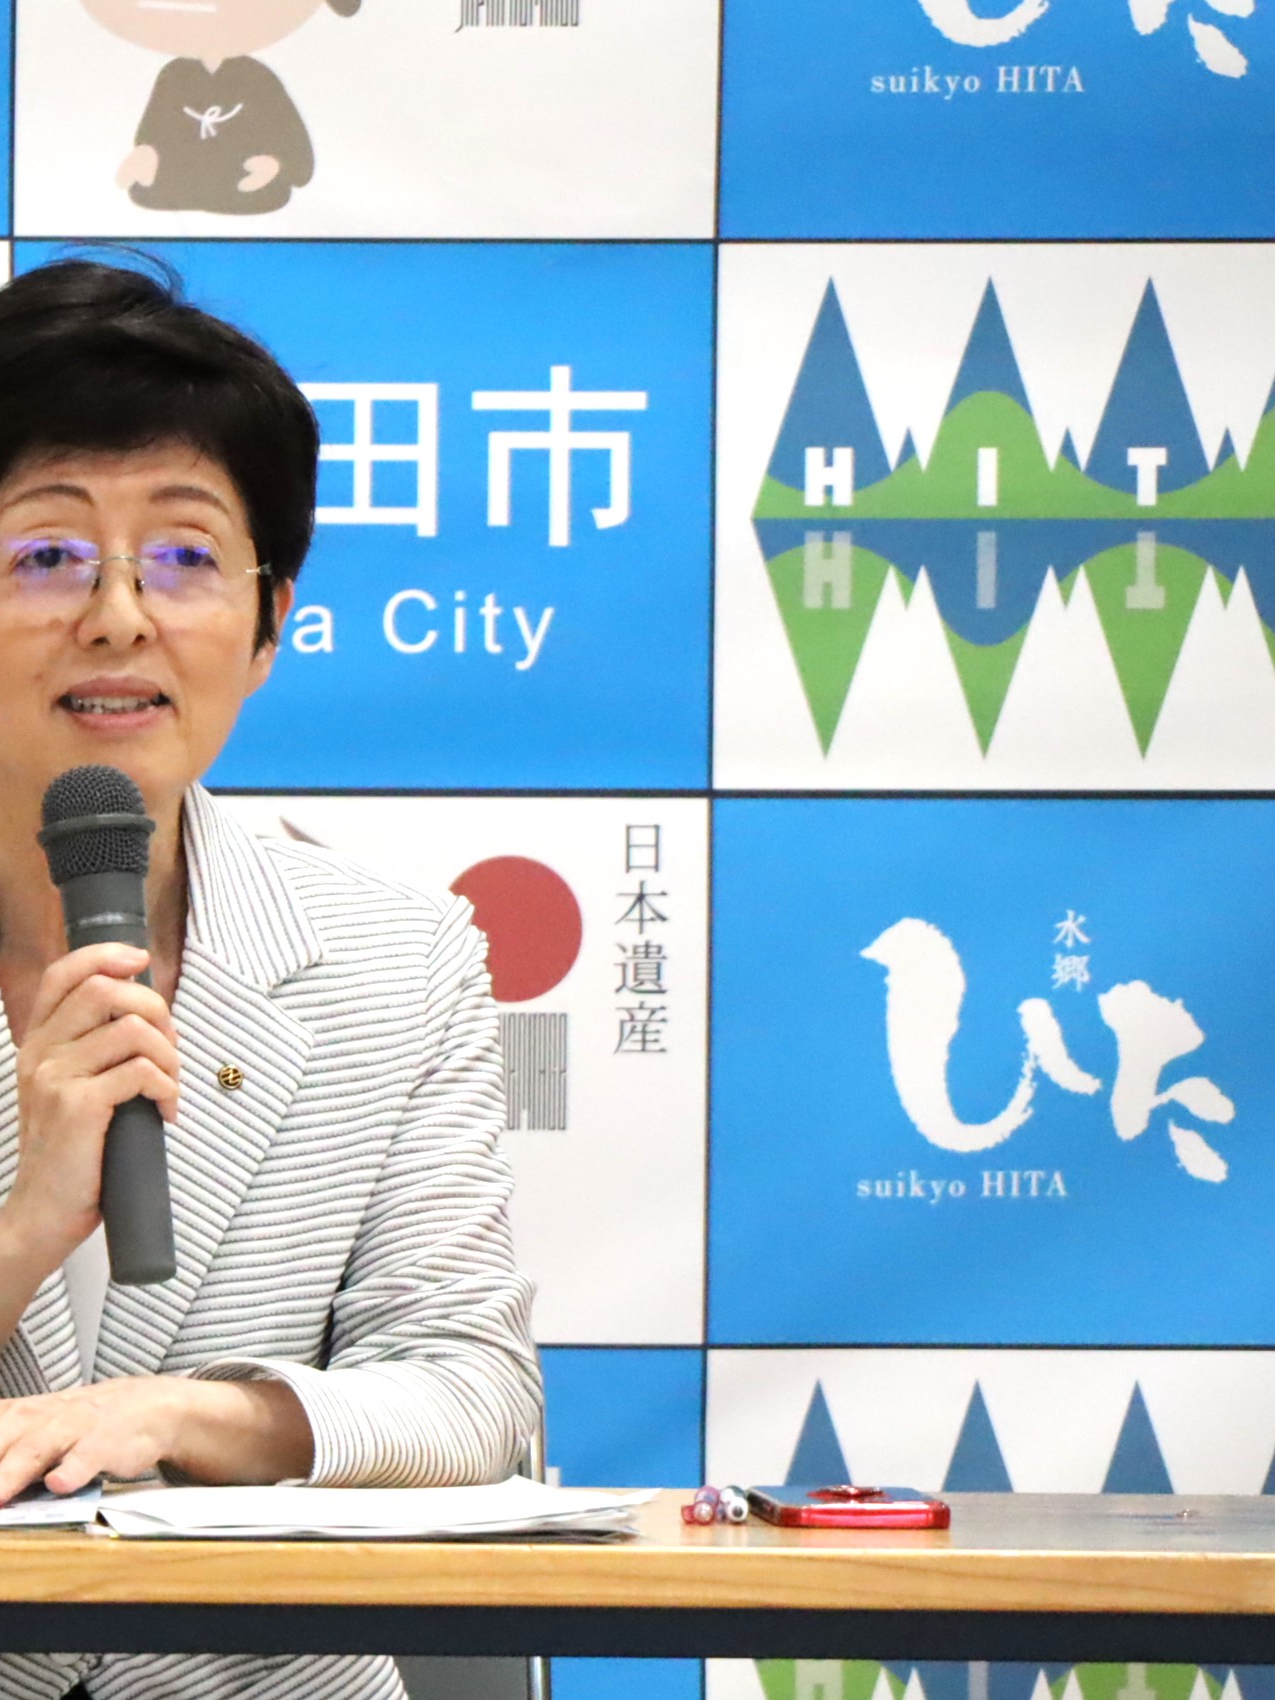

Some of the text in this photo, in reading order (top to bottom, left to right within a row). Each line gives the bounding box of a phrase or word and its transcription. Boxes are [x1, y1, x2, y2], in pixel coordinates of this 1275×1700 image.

[870, 65, 1085, 100] suikyo HITA
[297, 364, 649, 548] 田市
[381, 588, 556, 671] City
[614, 823, 669, 1054] 日本遺産
[856, 1170, 1069, 1205] suikyo HITA
